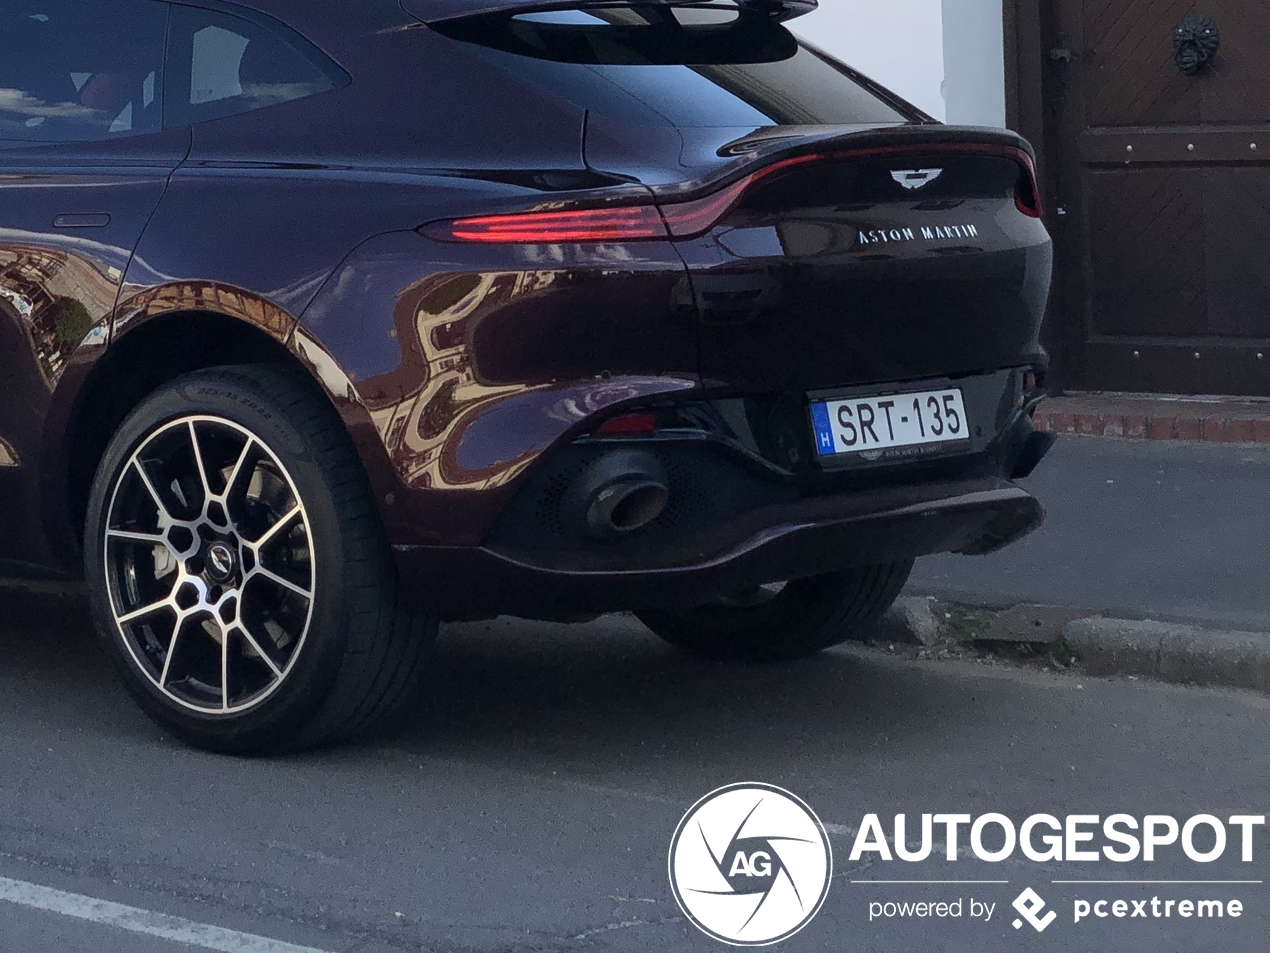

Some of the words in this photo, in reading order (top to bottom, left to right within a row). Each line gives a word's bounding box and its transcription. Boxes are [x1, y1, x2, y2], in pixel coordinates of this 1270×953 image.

[859, 228, 914, 244] ASTON
[921, 225, 978, 239] MARTIN
[837, 395, 960, 446] SRT-135
[820, 432, 830, 447] H
